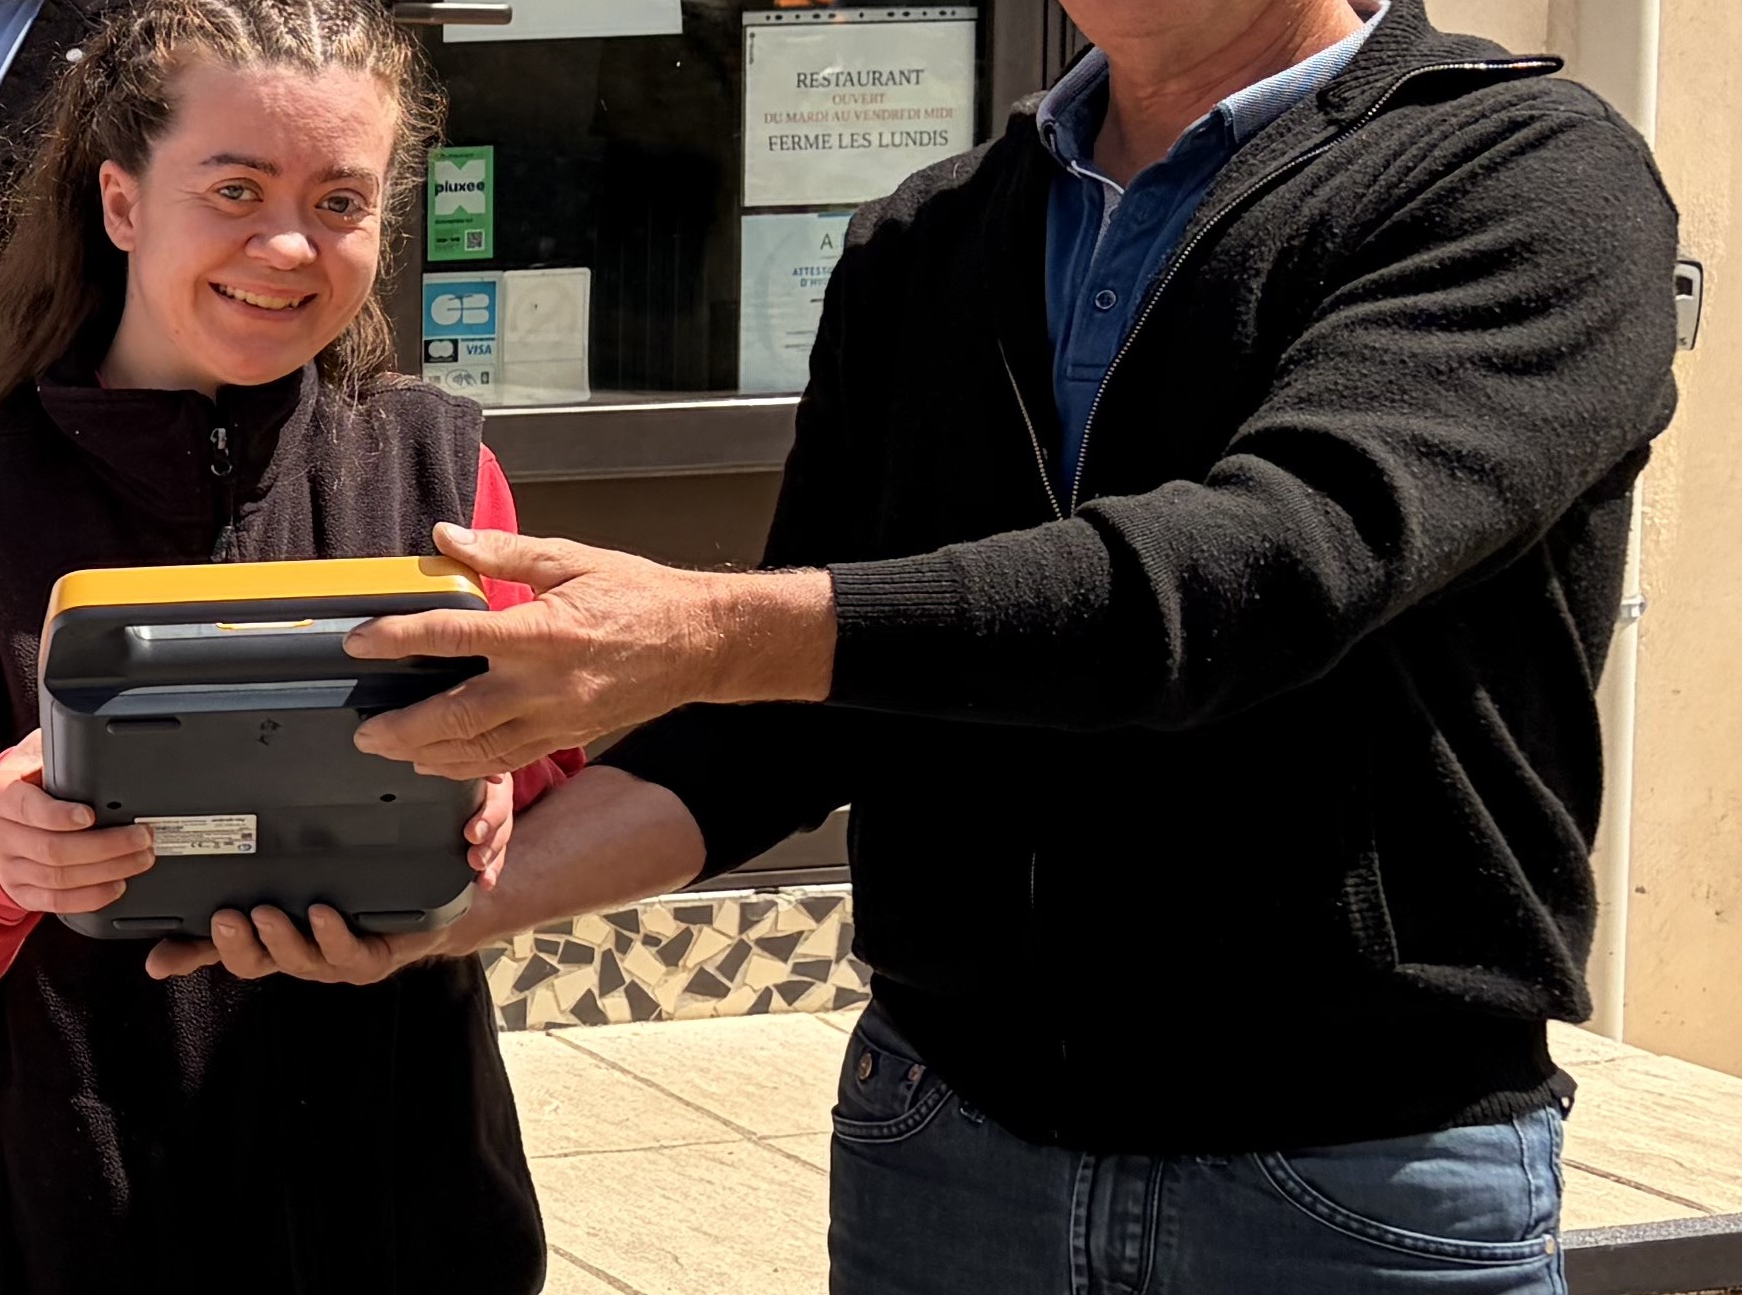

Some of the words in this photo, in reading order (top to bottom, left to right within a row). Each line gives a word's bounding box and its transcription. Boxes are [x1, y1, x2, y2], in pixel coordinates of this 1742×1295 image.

[796, 68, 925, 89] RESTAURANT
[832, 92, 886, 106] OUVERT
[764, 113, 783, 124] DU
[786, 111, 829, 123] MARDI
[831, 110, 850, 122] AU
[853, 108, 922, 121] VENDREDI
[923, 107, 954, 119] MIDI
[768, 133, 833, 151] FERME
[838, 132, 873, 149] LES
[878, 130, 950, 148] LUNDIS
[466, 344, 492, 355] VISA
